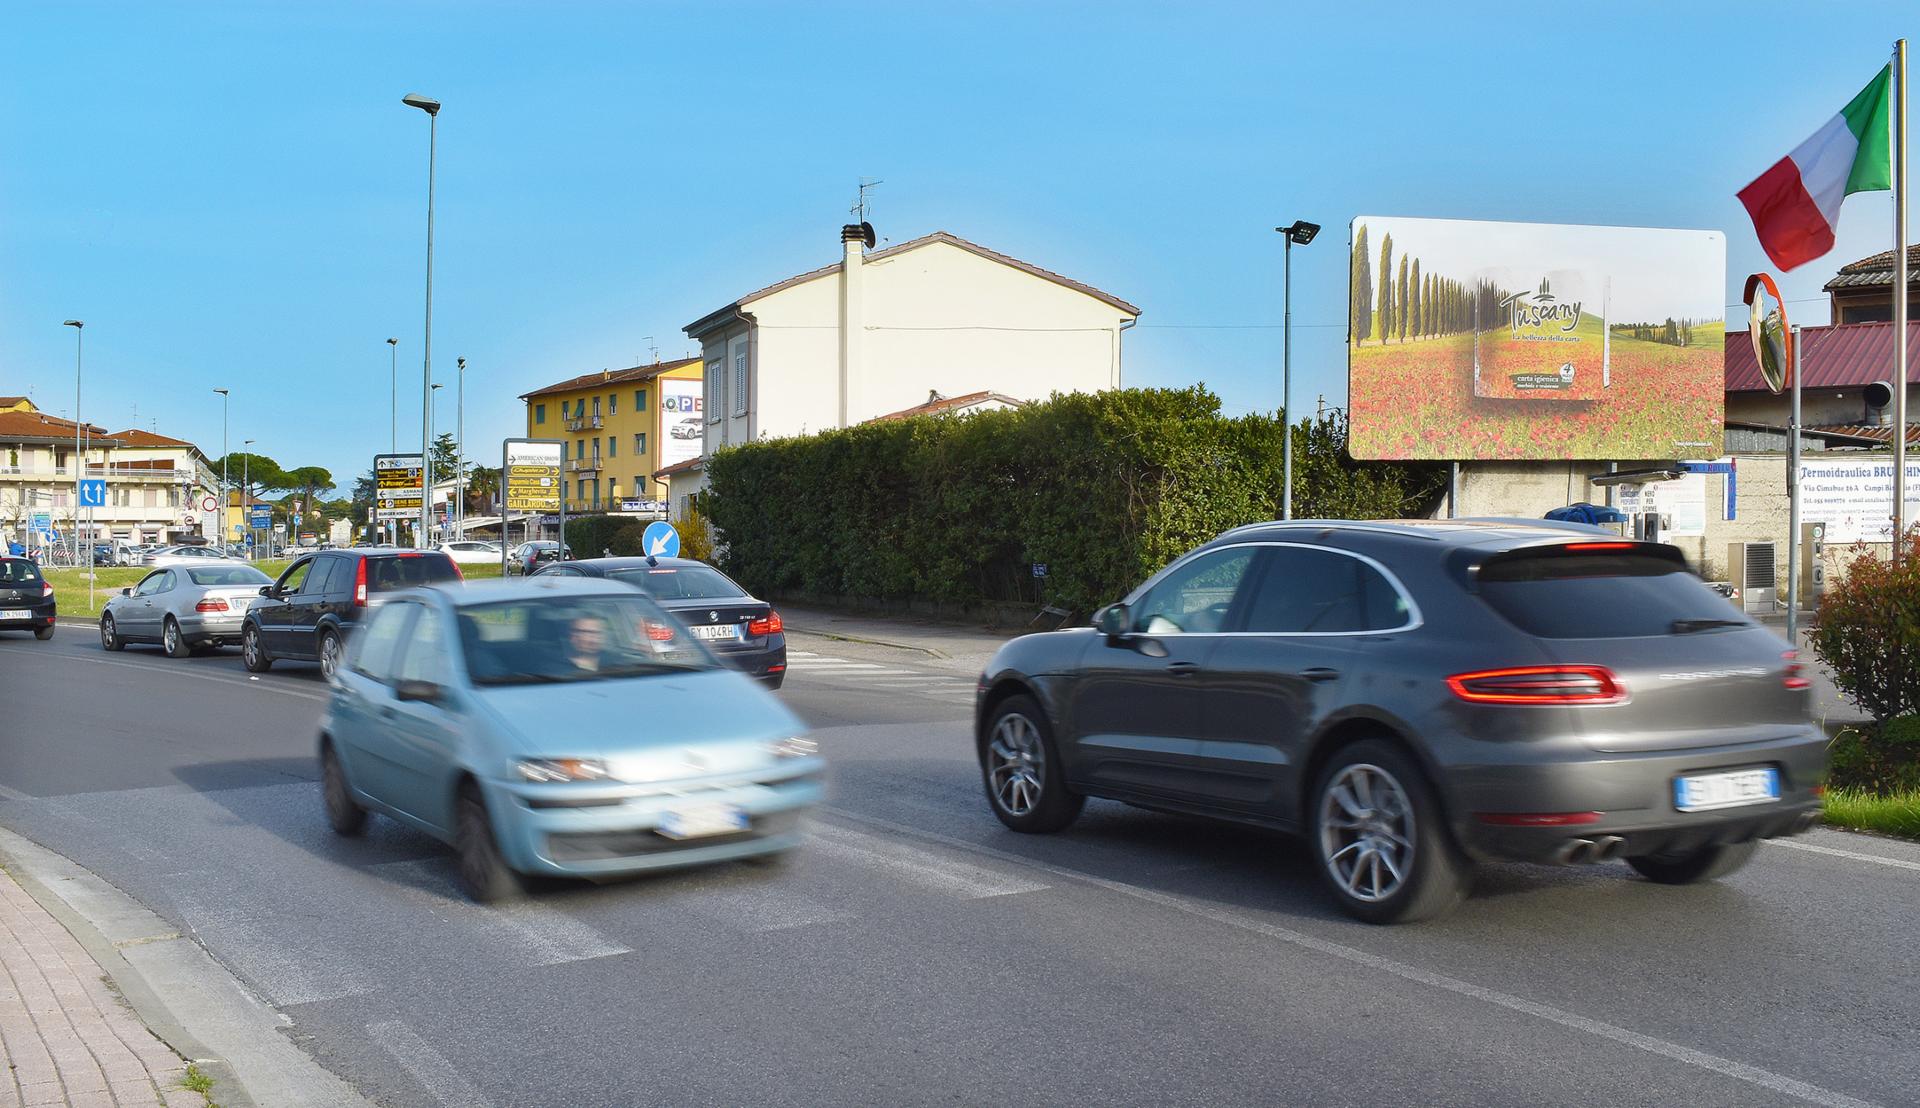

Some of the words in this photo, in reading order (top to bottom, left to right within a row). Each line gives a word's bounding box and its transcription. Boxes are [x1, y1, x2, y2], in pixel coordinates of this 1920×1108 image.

[1500, 290, 1582, 332] Tuscany
[1549, 334, 1564, 342] della
[1563, 363, 1572, 374] 4
[1534, 375, 1559, 383] igienica
[1801, 466, 1872, 478] Termoidraulica
[1816, 484, 1845, 492] Cimabue
[1864, 484, 1884, 492] Campi
[706, 626, 733, 638] 104RH
